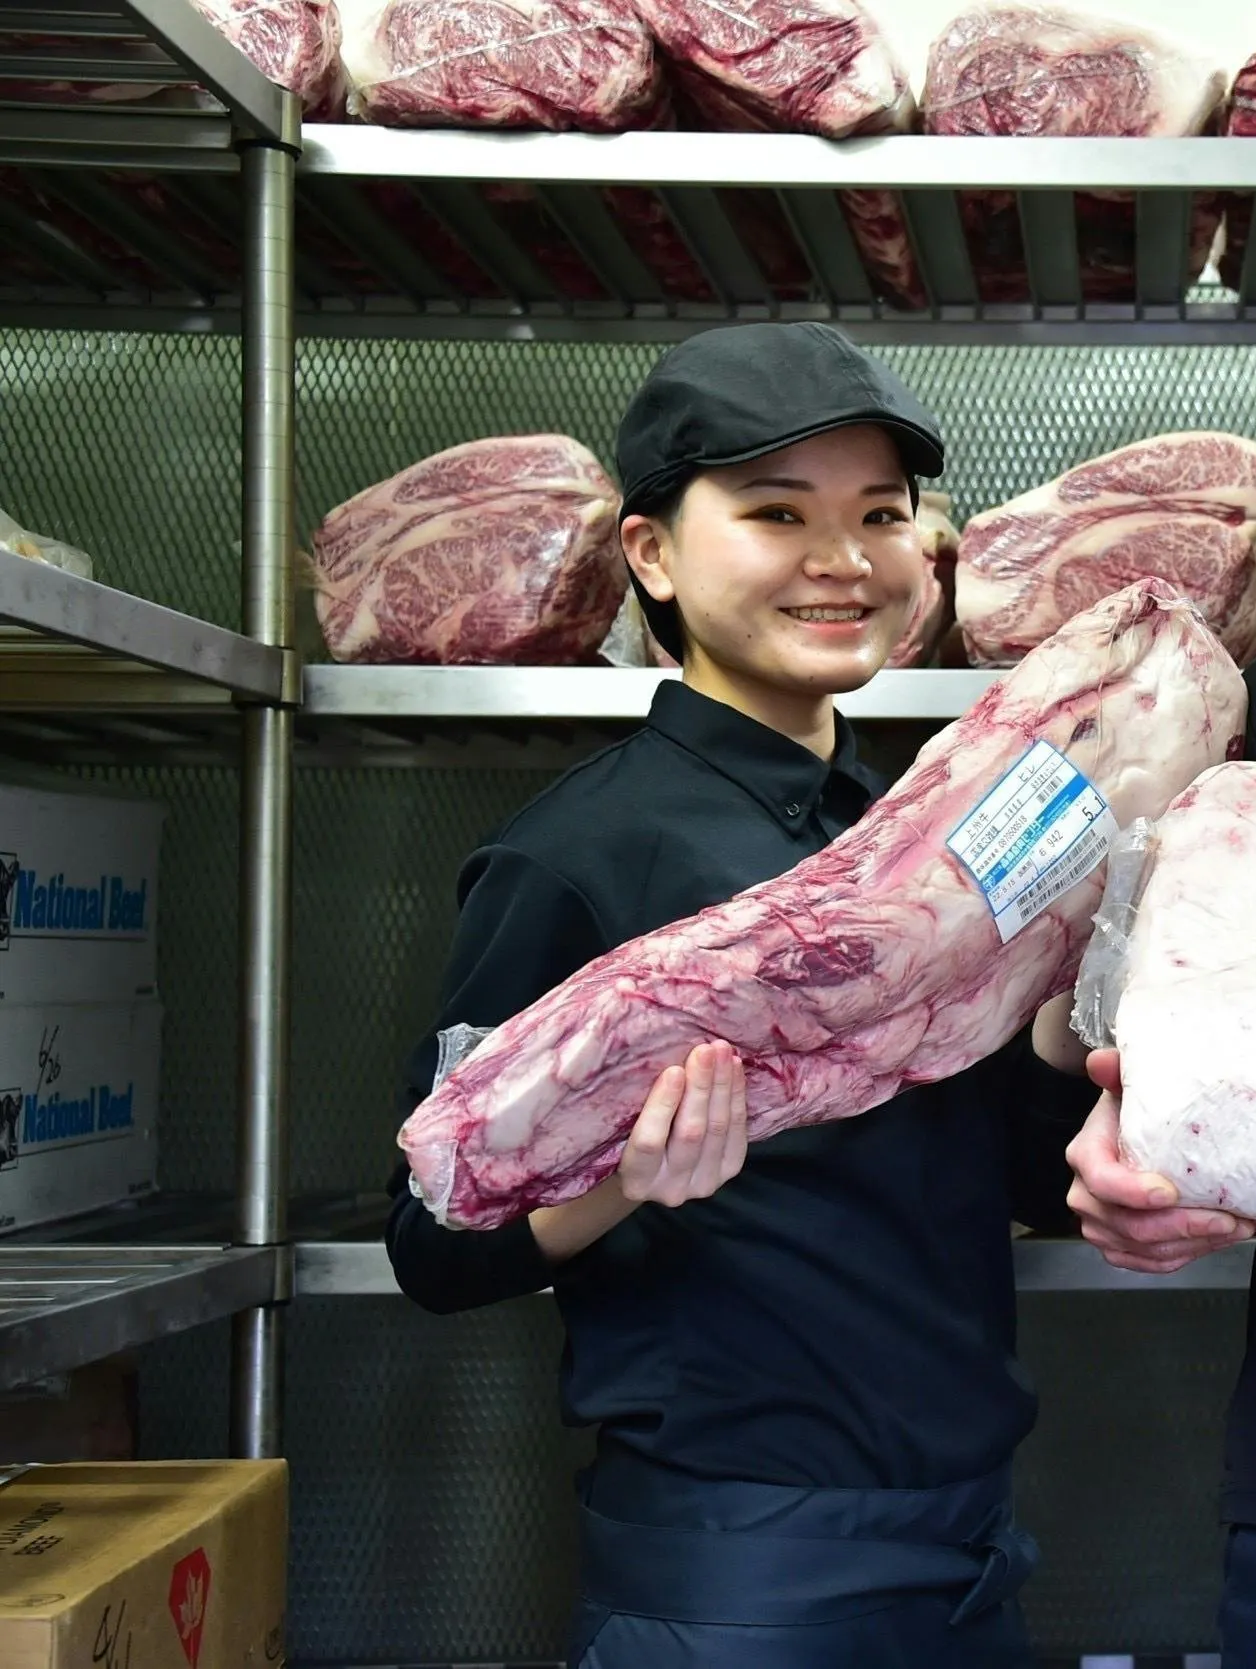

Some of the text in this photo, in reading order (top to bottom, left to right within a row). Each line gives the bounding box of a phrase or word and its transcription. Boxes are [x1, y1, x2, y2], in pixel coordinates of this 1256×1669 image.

[1017, 765, 1036, 783] ヒレ
[1046, 829, 1064, 848] 942
[13, 870, 106, 930] National
[23, 1087, 95, 1144] National
